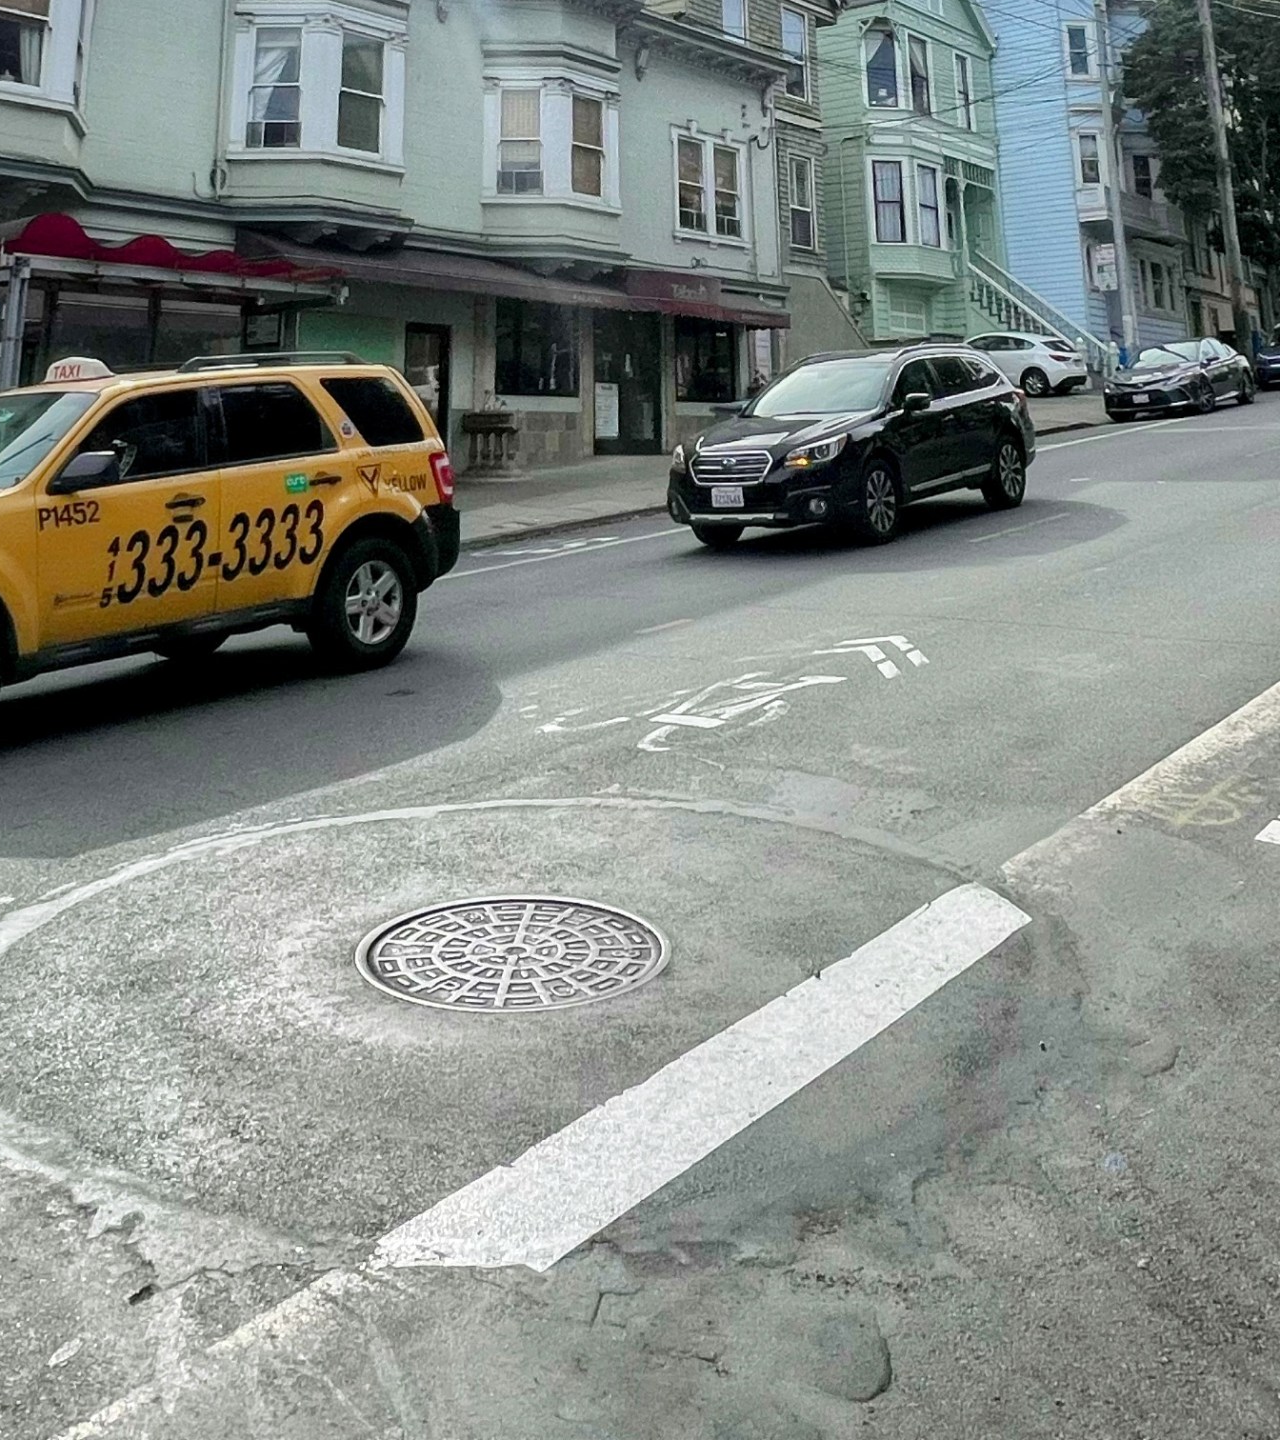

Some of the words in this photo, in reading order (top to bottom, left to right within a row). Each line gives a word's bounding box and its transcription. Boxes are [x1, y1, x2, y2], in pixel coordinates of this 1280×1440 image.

[53, 365, 81, 380] TAXI
[383, 473, 427, 493] YELLOW
[37, 500, 101, 532] P1452
[117, 499, 324, 604] 333-3333
